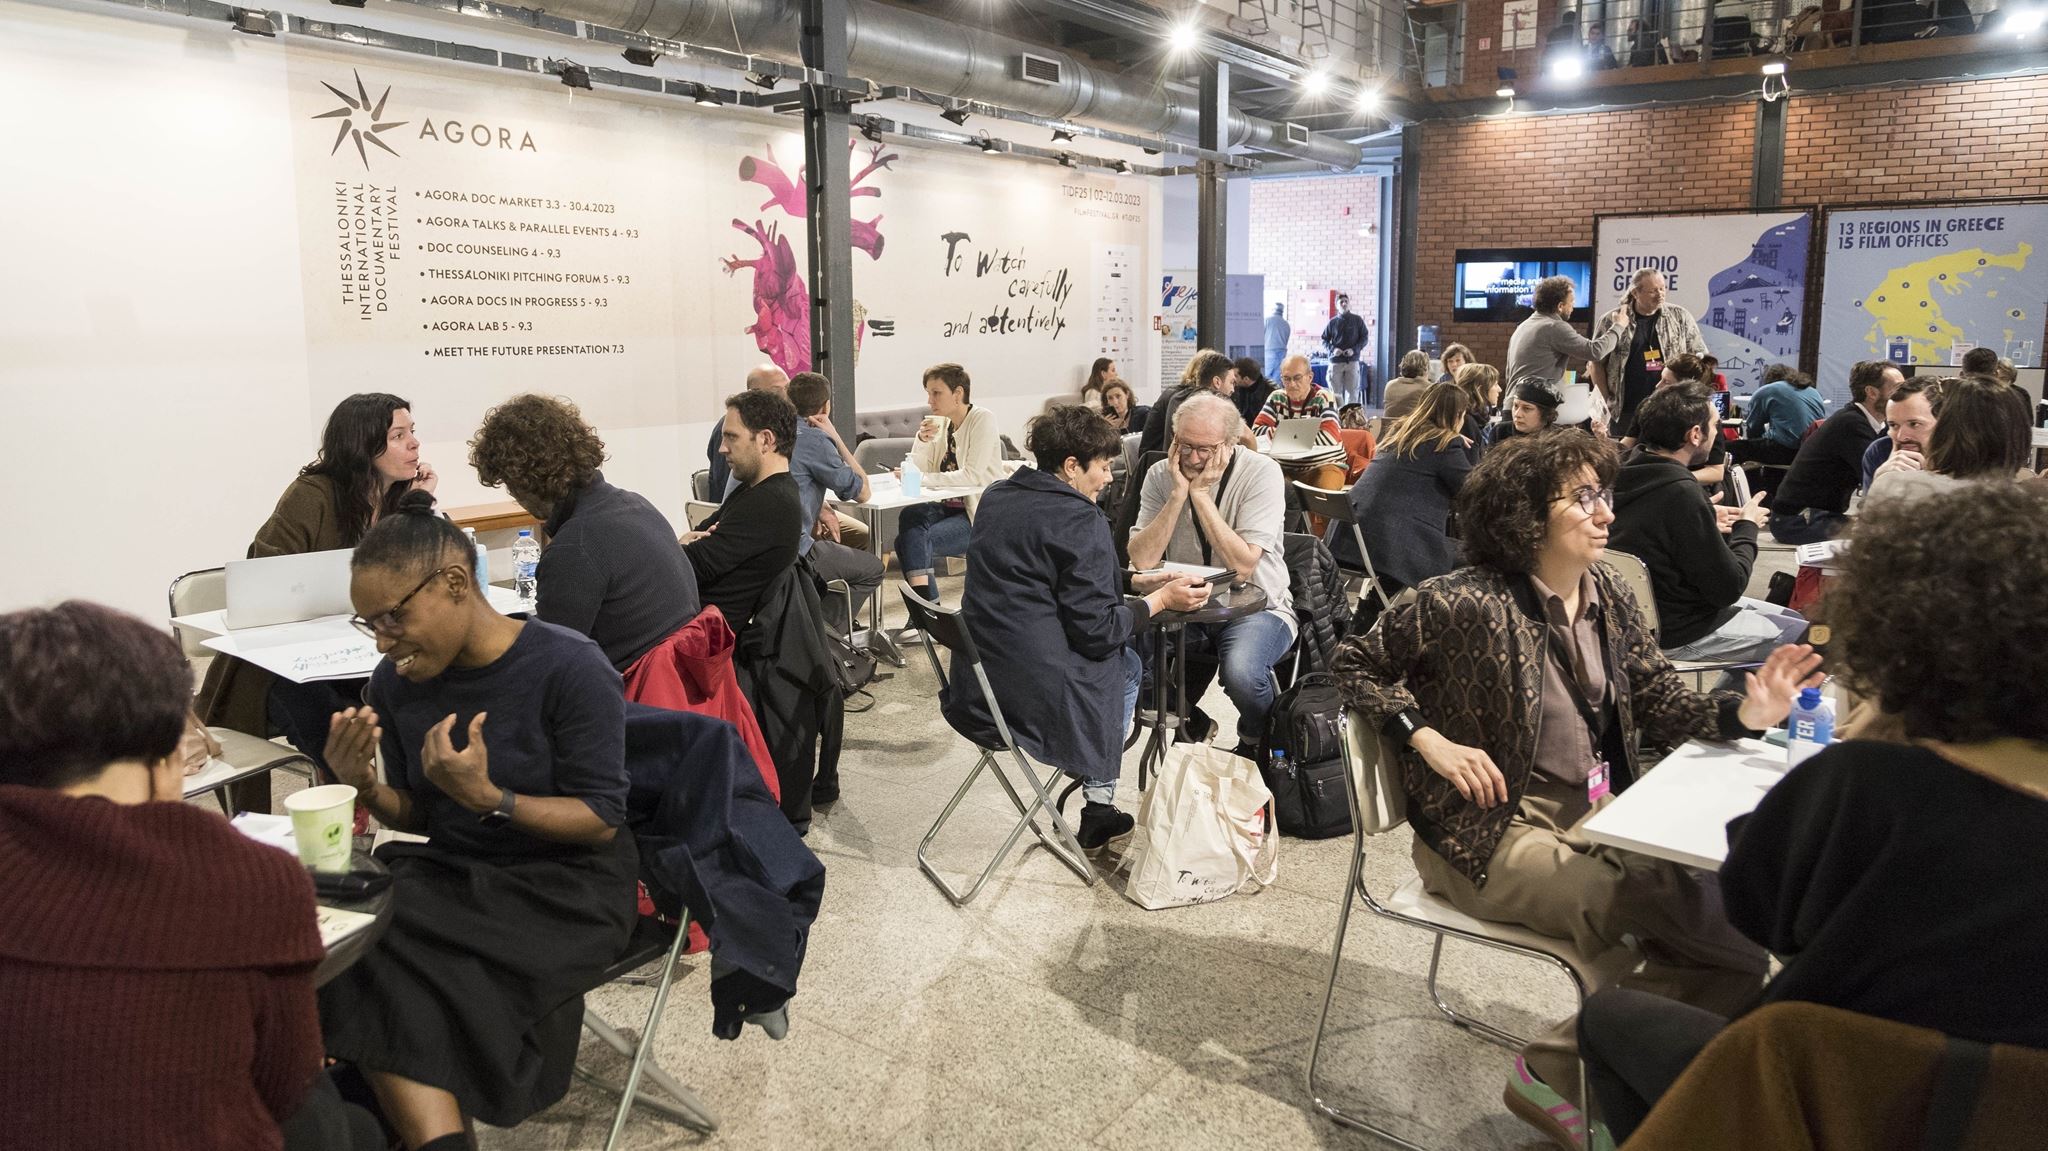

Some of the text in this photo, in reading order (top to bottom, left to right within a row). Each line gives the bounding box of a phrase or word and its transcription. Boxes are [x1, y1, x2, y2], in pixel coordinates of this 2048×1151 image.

[418, 117, 537, 152] AGORA
[424, 190, 468, 202] AGORA
[471, 193, 496, 205] DOC
[499, 197, 543, 208] MARKET
[546, 199, 560, 209] 3.3
[569, 201, 615, 214] 30.4.2023
[1094, 189, 1141, 206] 02-12.03.2023
[386, 185, 400, 260] FESTIVAL
[426, 216, 470, 229] AGORA
[472, 219, 506, 231] TALKS
[509, 222, 517, 232] &
[520, 222, 571, 235] PARALLEL
[573, 225, 610, 237] EVENTS
[612, 229, 618, 237] 4
[626, 229, 639, 238] 9.3
[1839, 217, 2005, 235] 13 REGIONS IN GREECE
[335, 181, 354, 305] THESSALONIKI
[353, 183, 372, 320] INTERNATIONAL
[369, 184, 388, 312] DOCUMENTARY
[427, 242, 453, 254] DOC
[456, 244, 529, 257] COUNSELING
[532, 248, 538, 257] 4
[547, 249, 561, 258] 9.3
[1838, 233, 1949, 250] 15 FILM OFFICES
[940, 231, 971, 277] To
[1614, 255, 1678, 273] STUDIO
[513, 271, 563, 283] PITCHING
[565, 273, 602, 284] FORUM
[603, 275, 609, 284] 5
[617, 275, 630, 285] 9.3
[1008, 267, 1073, 310] carefully
[430, 295, 474, 305] AGORA
[477, 296, 507, 306] DOCS
[510, 297, 522, 306] IN
[525, 297, 578, 307] PROGRESS
[580, 297, 586, 307] 5
[594, 298, 608, 307] 9.3
[431, 321, 475, 331] AGORA
[478, 321, 500, 331] LAB
[502, 321, 508, 331] 5
[518, 321, 533, 331] 9.3
[943, 311, 972, 338] and
[433, 345, 625, 357] MEET THE FUTURE PRESENTATION 7.3
